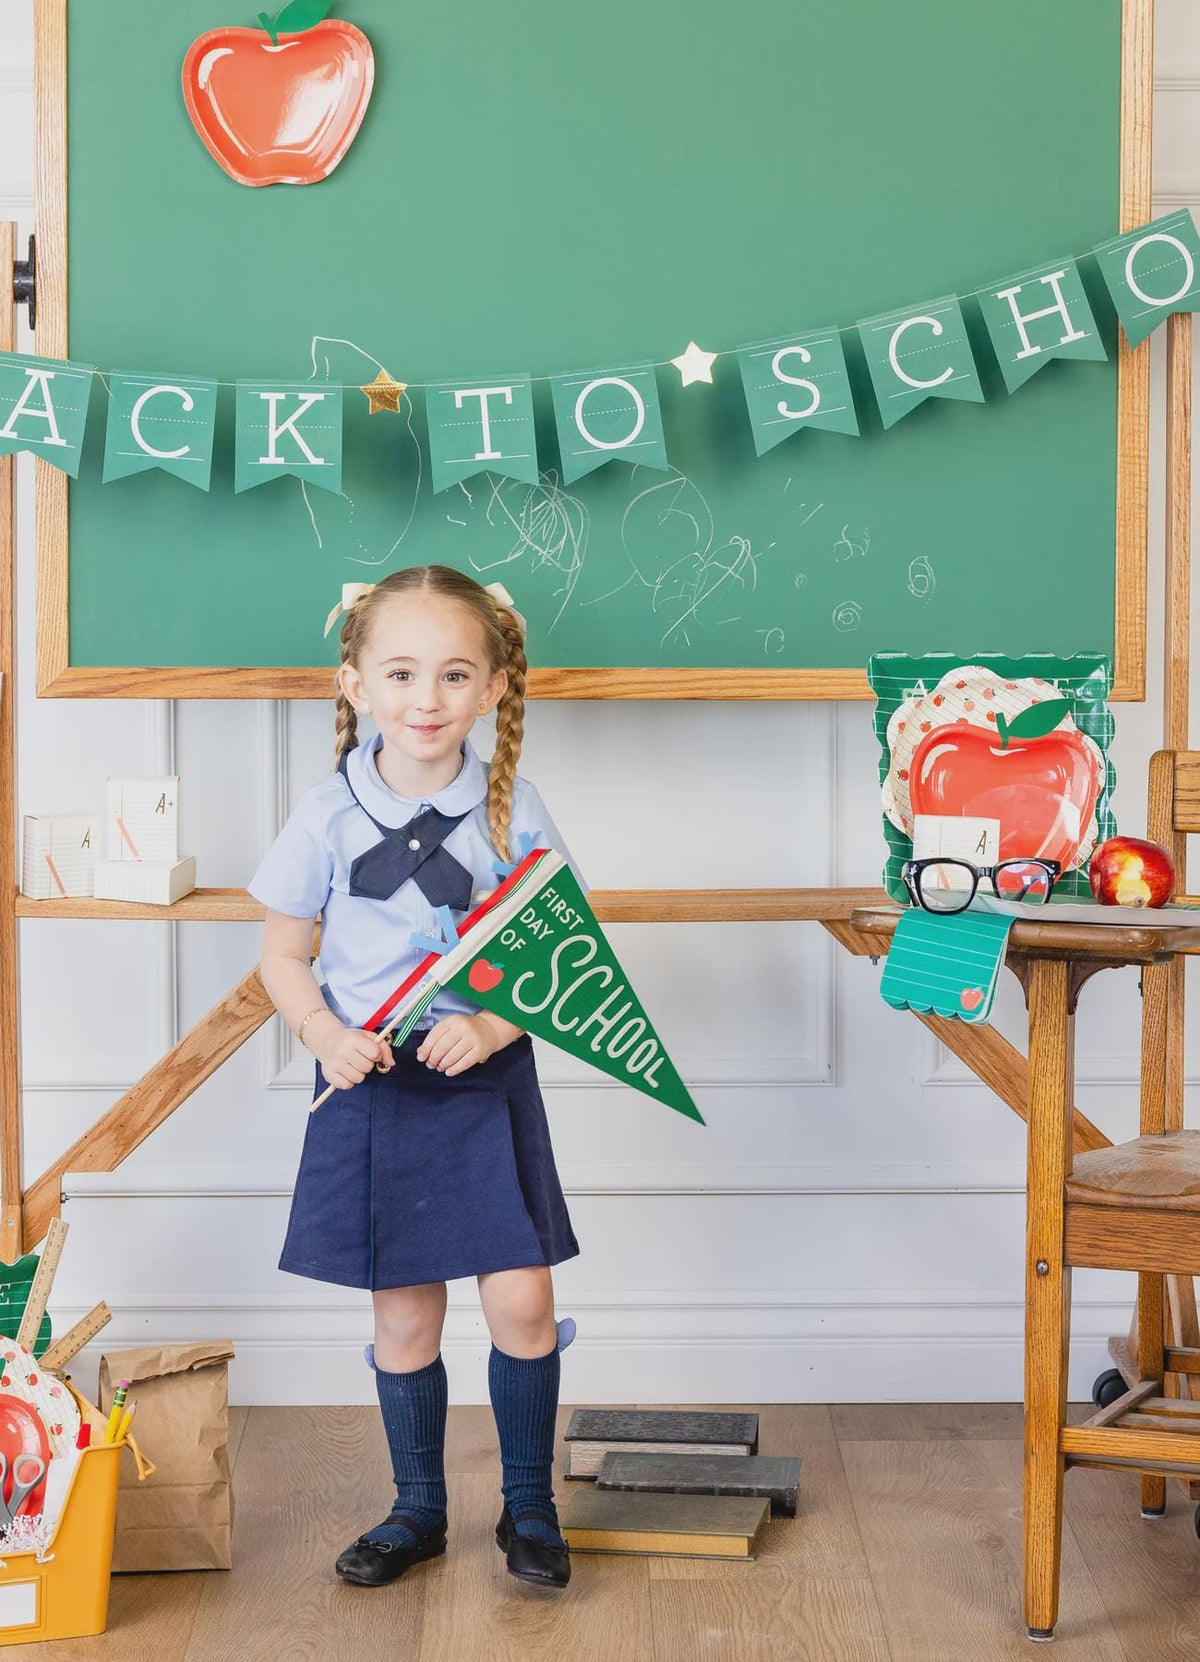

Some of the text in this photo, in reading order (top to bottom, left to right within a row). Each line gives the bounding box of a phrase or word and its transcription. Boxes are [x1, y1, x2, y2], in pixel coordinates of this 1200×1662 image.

[455, 377, 645, 460] TO
[771, 233, 1195, 420] SCHO
[155, 792, 174, 815] A+
[519, 908, 554, 941] DAY
[540, 887, 585, 931] FIRST
[500, 931, 527, 952] OF
[511, 934, 665, 1089] SCHOOL
